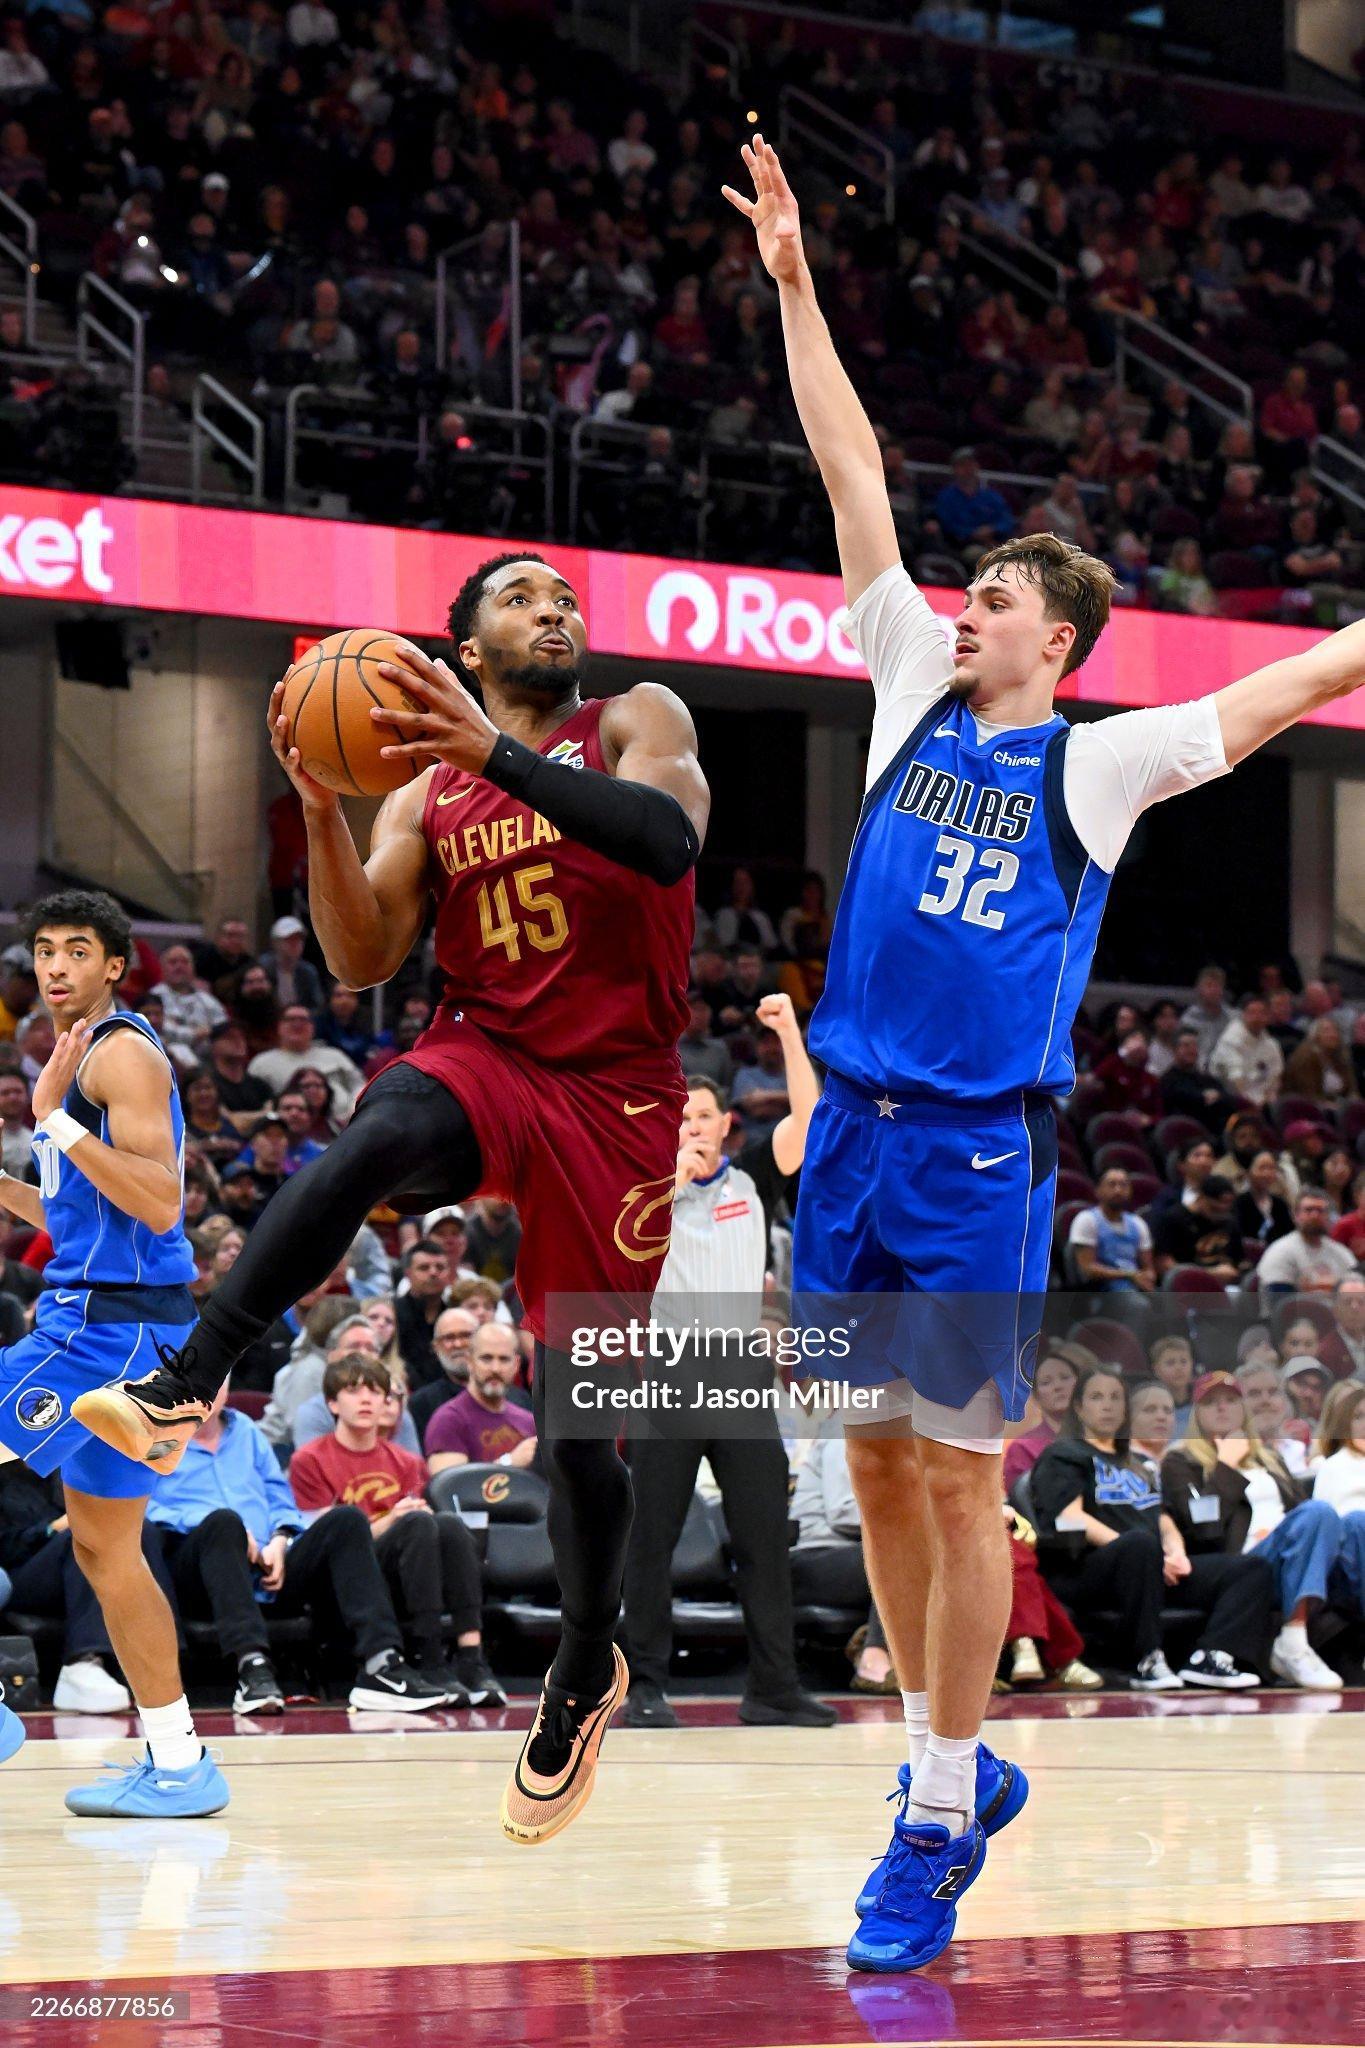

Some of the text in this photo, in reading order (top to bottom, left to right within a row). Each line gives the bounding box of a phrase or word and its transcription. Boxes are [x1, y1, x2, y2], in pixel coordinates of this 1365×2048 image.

[892, 760, 1036, 843] DALLAS
[993, 750, 1041, 767] Chime
[476, 861, 570, 963] 45
[917, 834, 1020, 931] 32
